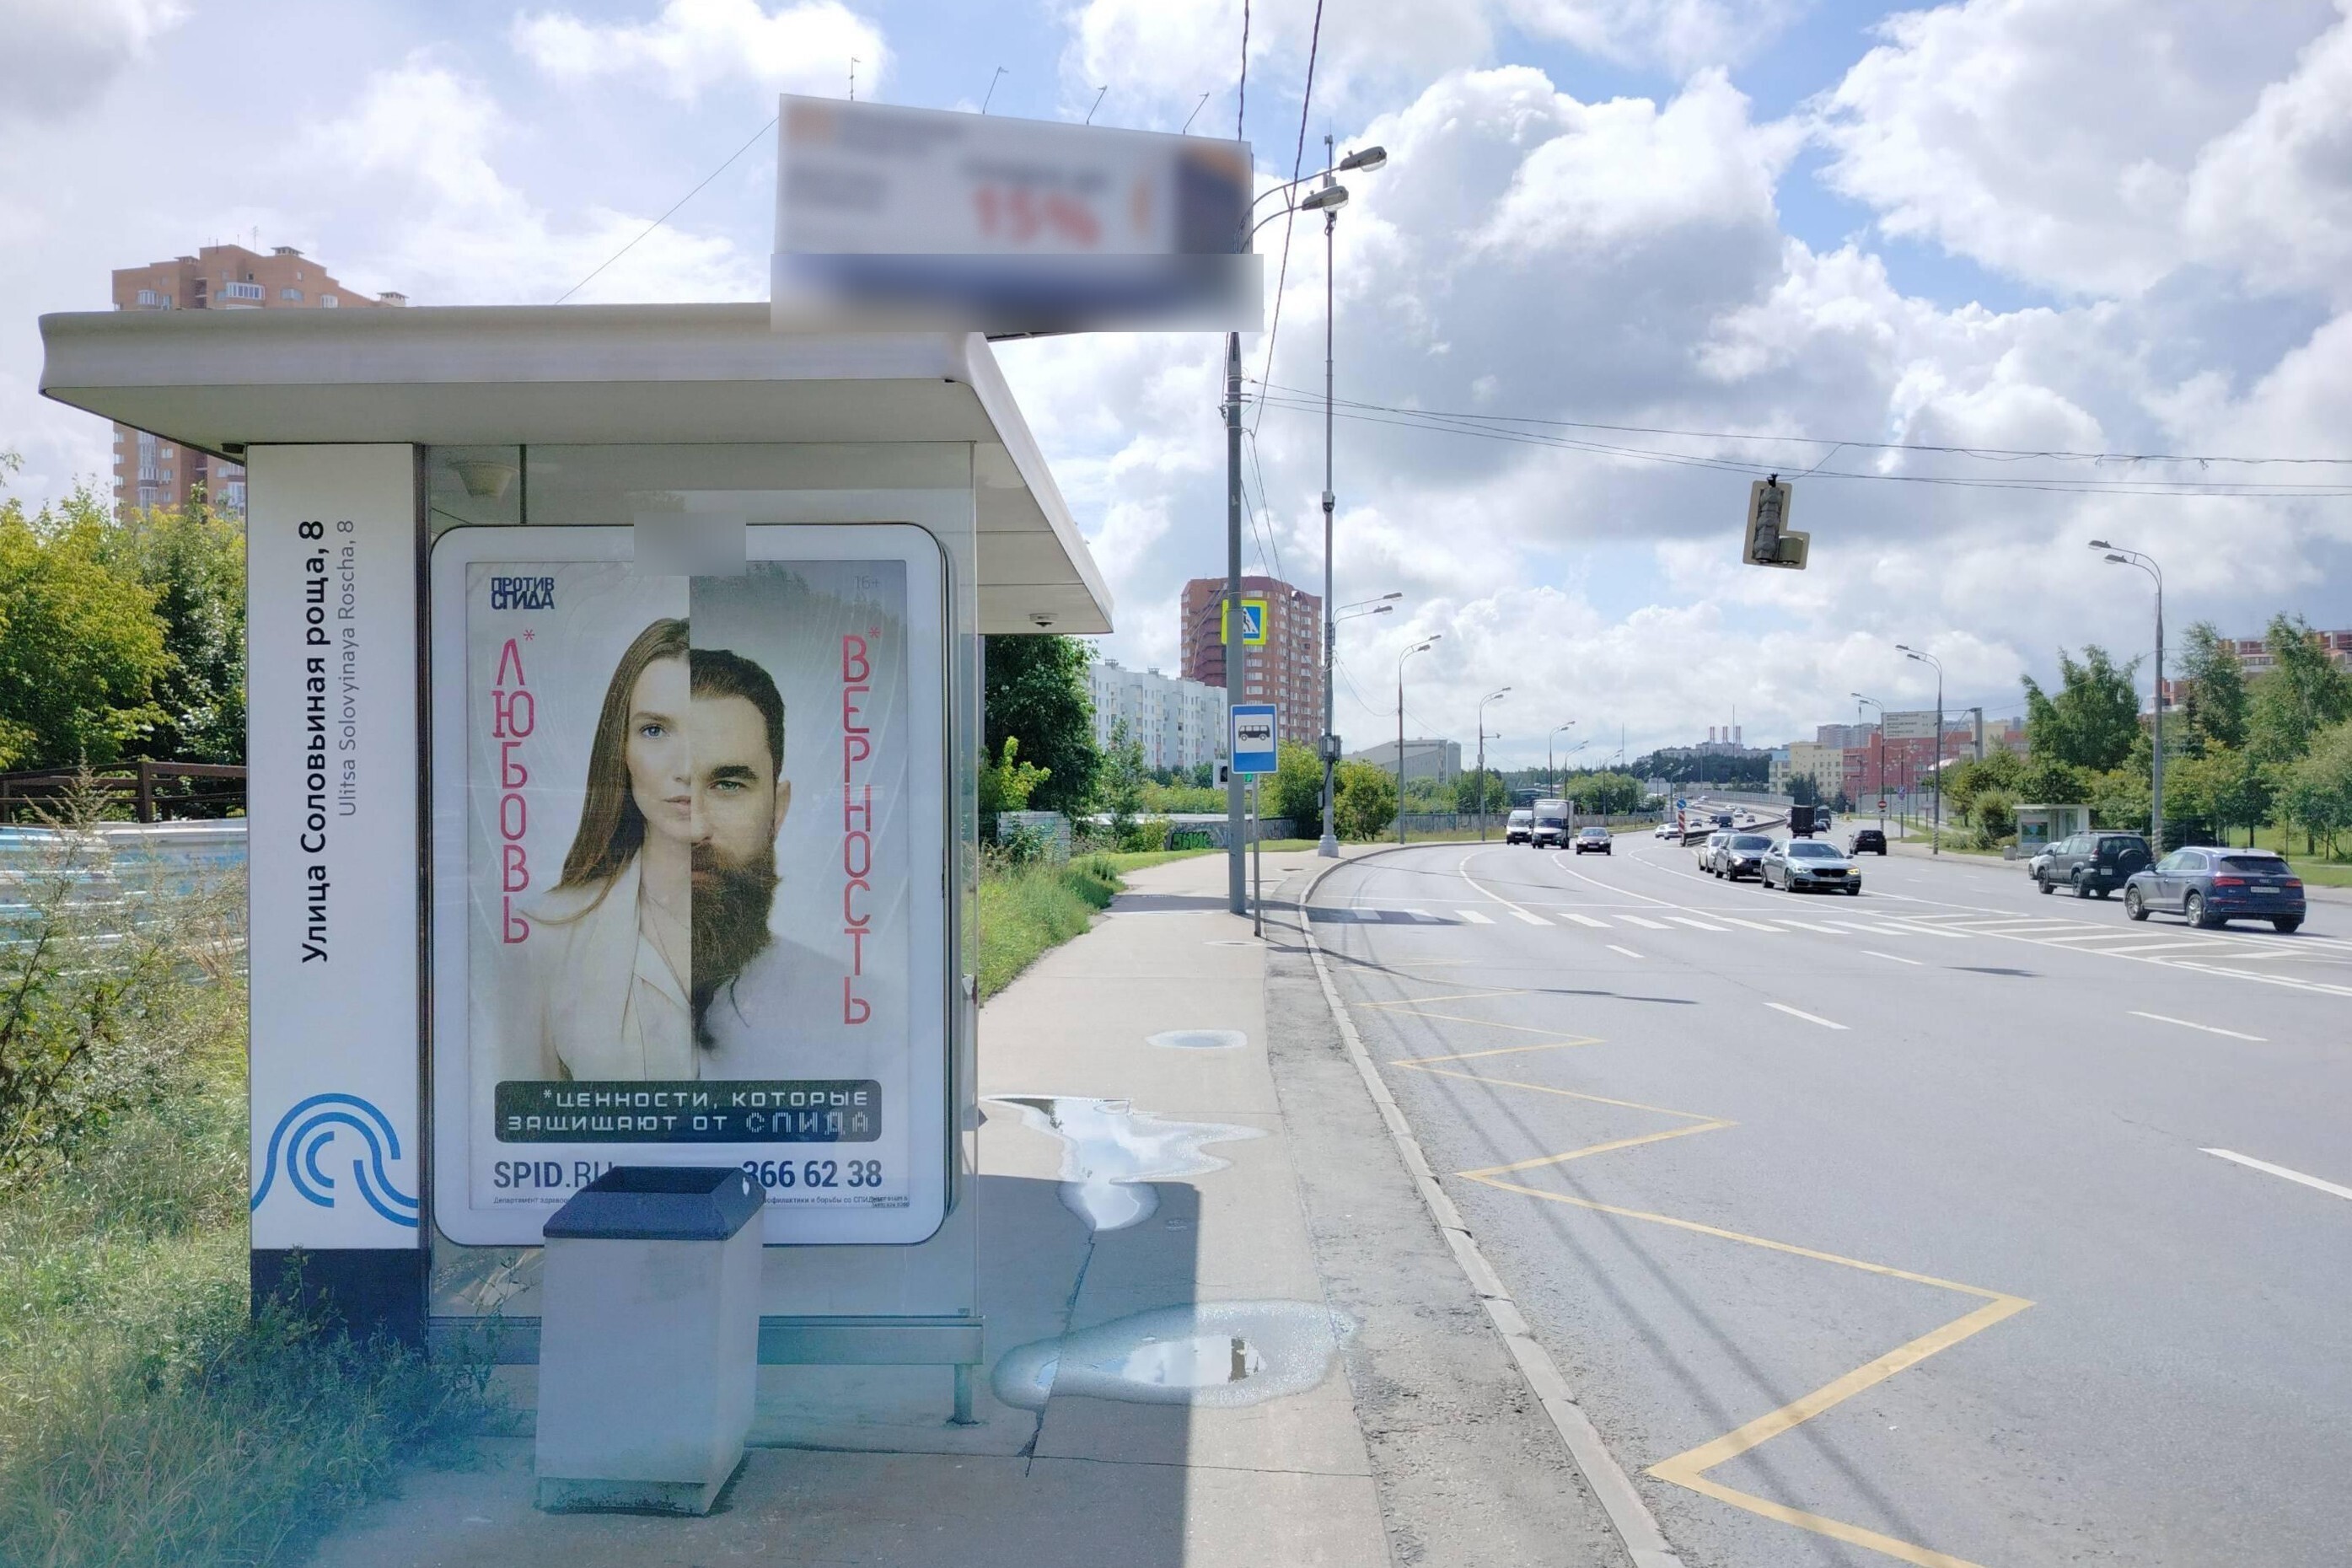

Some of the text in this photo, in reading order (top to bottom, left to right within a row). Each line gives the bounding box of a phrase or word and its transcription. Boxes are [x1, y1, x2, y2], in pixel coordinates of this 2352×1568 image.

[491, 577, 555, 592] ПРОТИВ
[855, 575, 880, 590] 16+
[491, 591, 555, 610] СПИДА
[336, 519, 359, 816] Ulitsa Solovyinaya Roscha, 8
[298, 520, 330, 963] Улица Соловьиная роща, 8
[732, 1091, 868, 1106] КОТОРЫЕ
[507, 1111, 868, 1136] ЗАЩИЩАЮТ ОТ СПИДА
[803, 1160, 839, 1188] 62
[847, 1159, 883, 1188] 38
